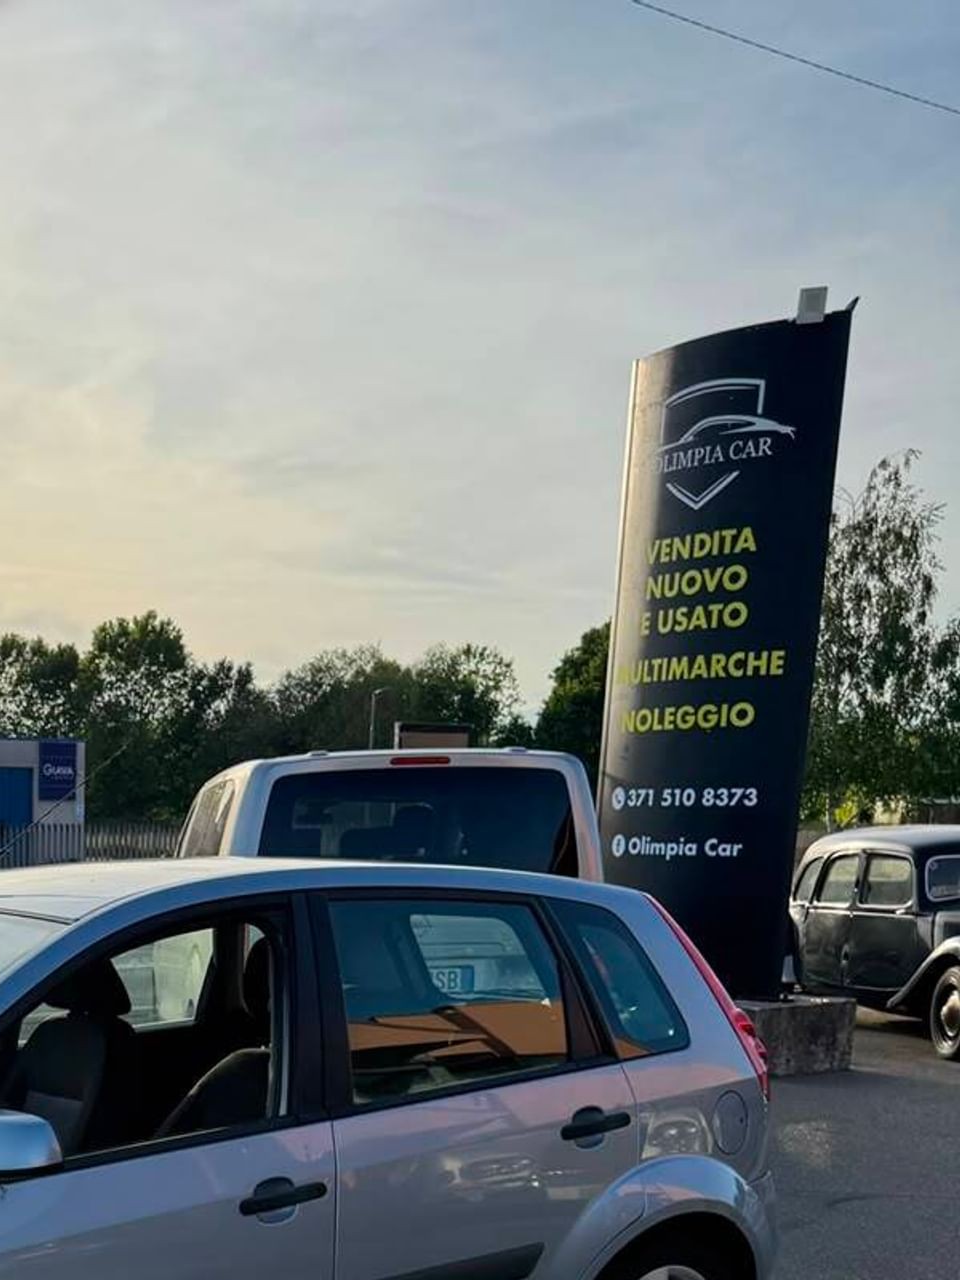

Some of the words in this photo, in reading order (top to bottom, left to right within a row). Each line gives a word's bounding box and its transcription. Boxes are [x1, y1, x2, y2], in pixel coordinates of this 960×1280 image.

[729, 437, 772, 460] CAR
[645, 527, 757, 564] VENDITA
[645, 564, 748, 600] NUOVO
[641, 612, 651, 636] E
[657, 601, 748, 634] USATO
[622, 702, 755, 733] NOLEGGIO
[627, 788, 654, 807] 371
[661, 788, 696, 807] 510
[702, 787, 758, 807] 8373
[628, 836, 697, 861] Olimpia
[704, 838, 743, 857] Car
